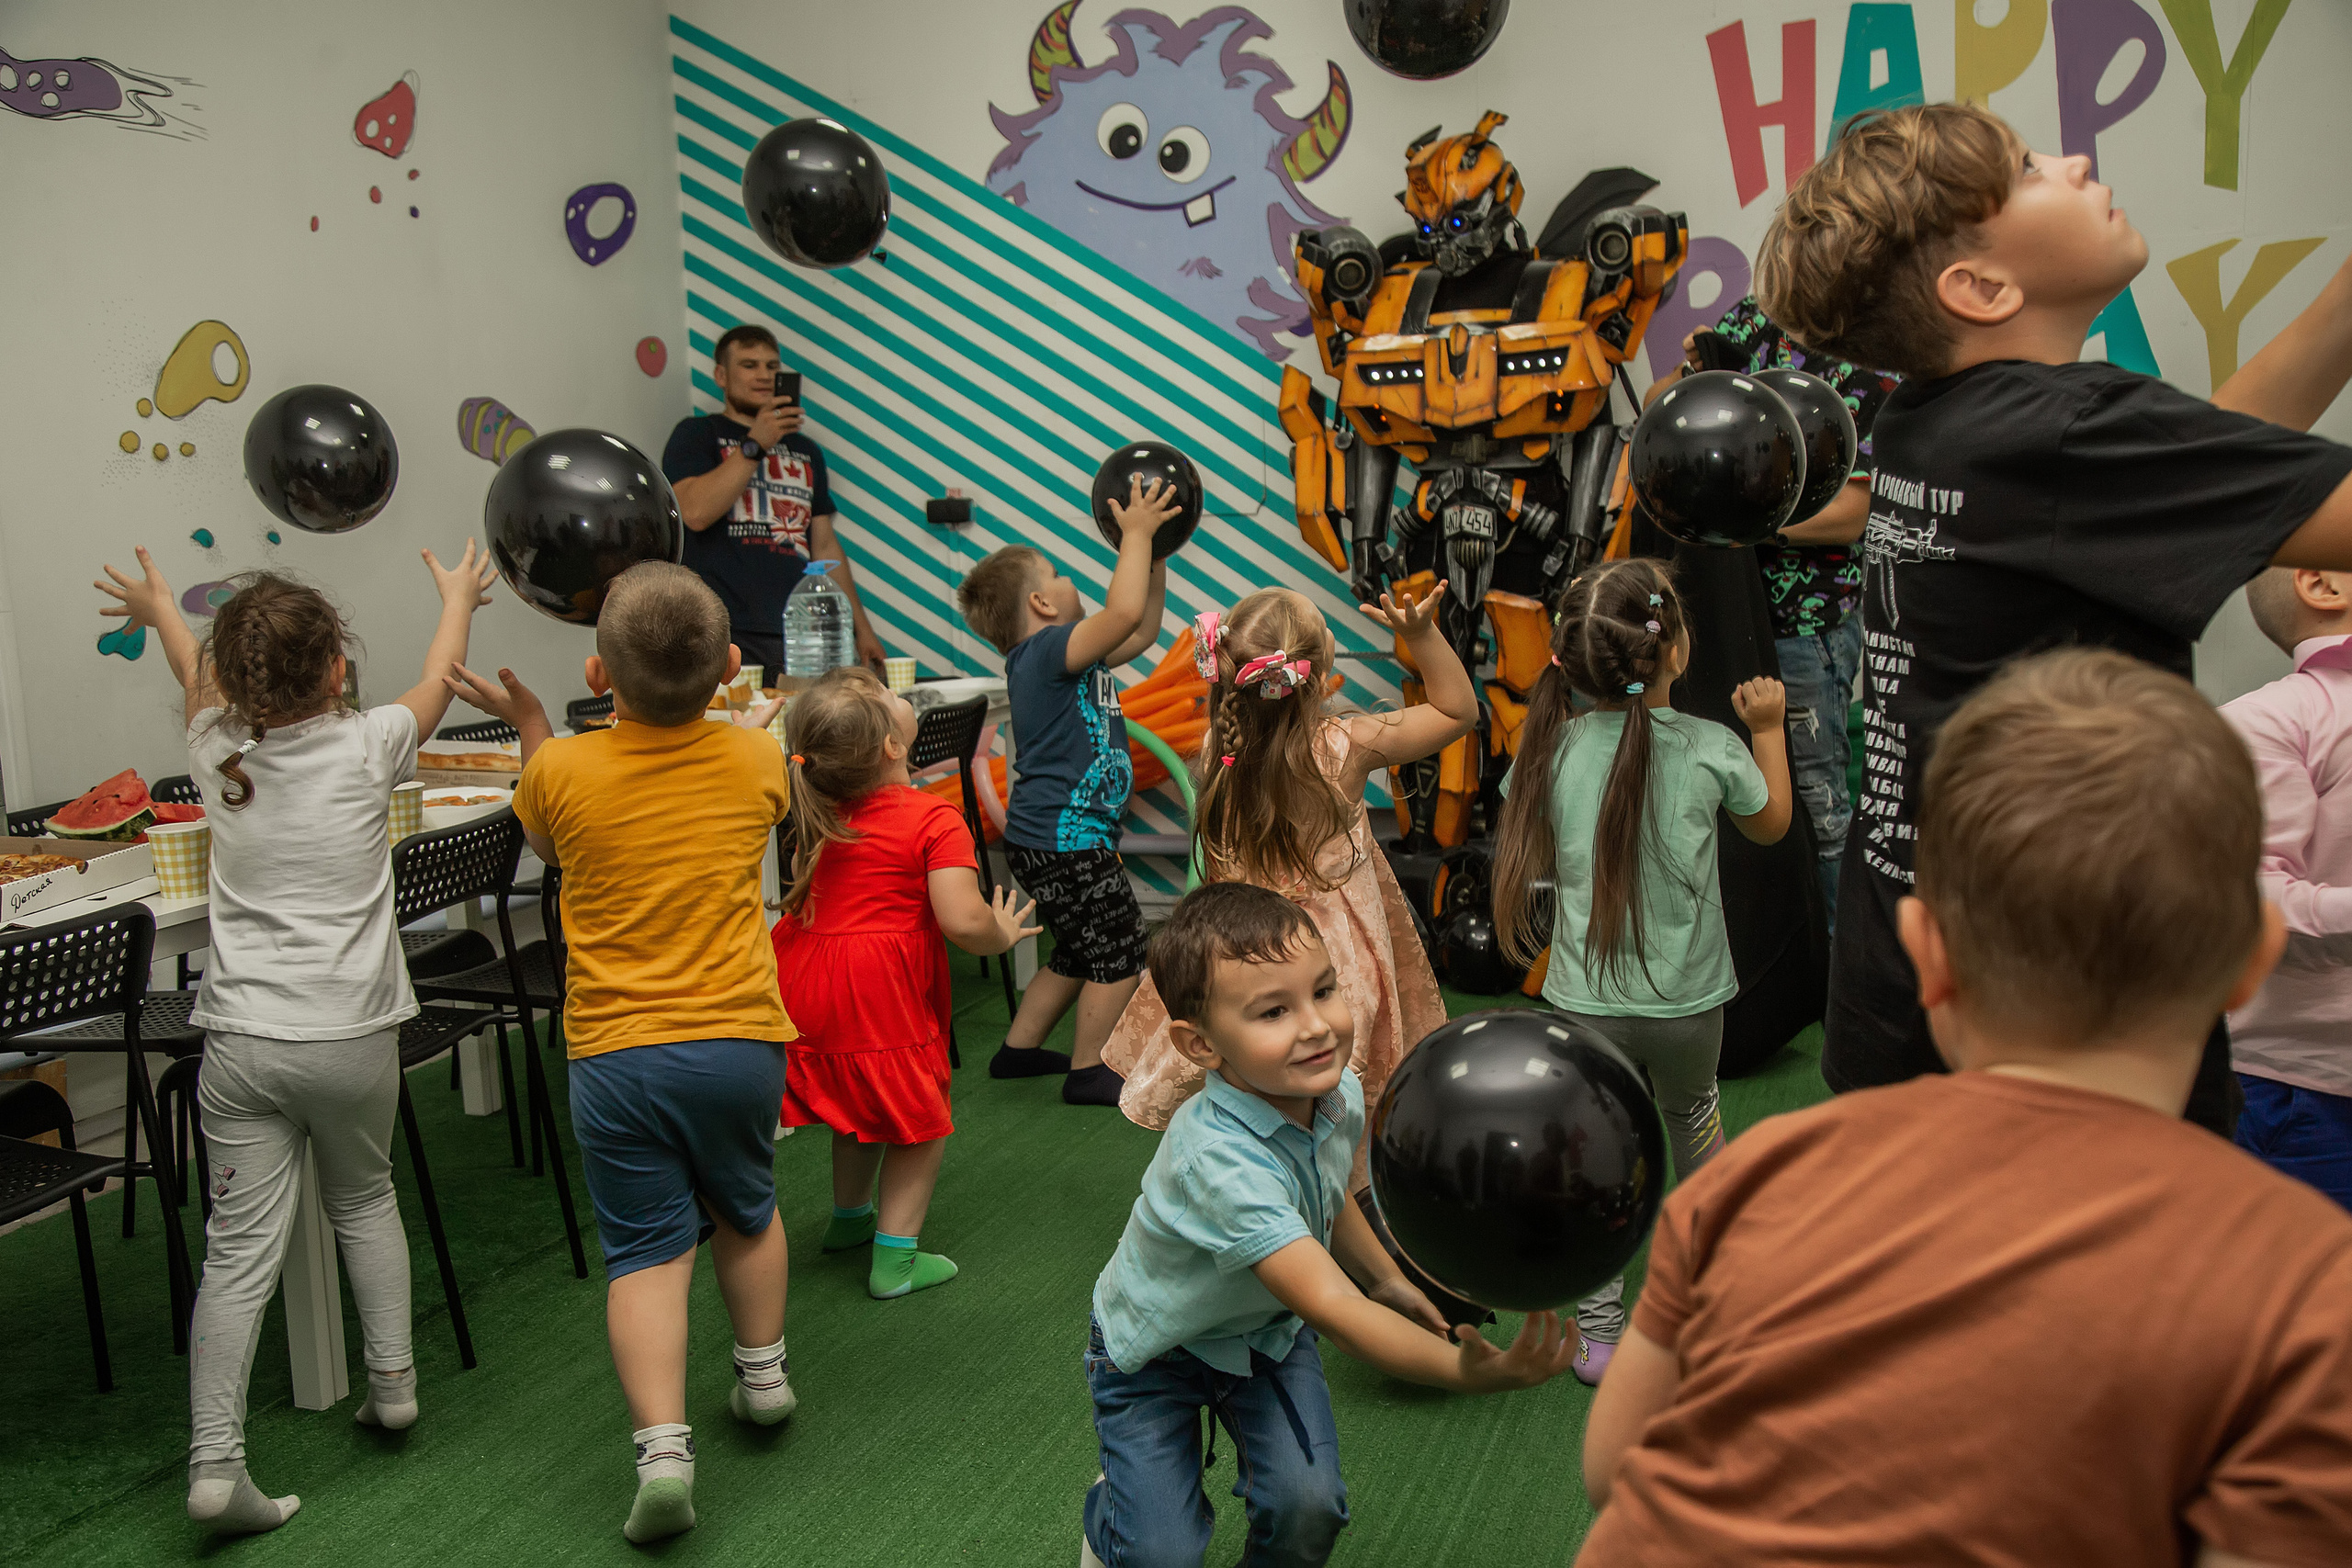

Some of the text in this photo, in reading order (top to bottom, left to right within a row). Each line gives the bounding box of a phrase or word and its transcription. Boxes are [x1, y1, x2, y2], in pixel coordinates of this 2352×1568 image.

[1706, 0, 2291, 209] HAPPY
[1929, 488, 1964, 515] ТУР
[11, 877, 52, 913] Детская
